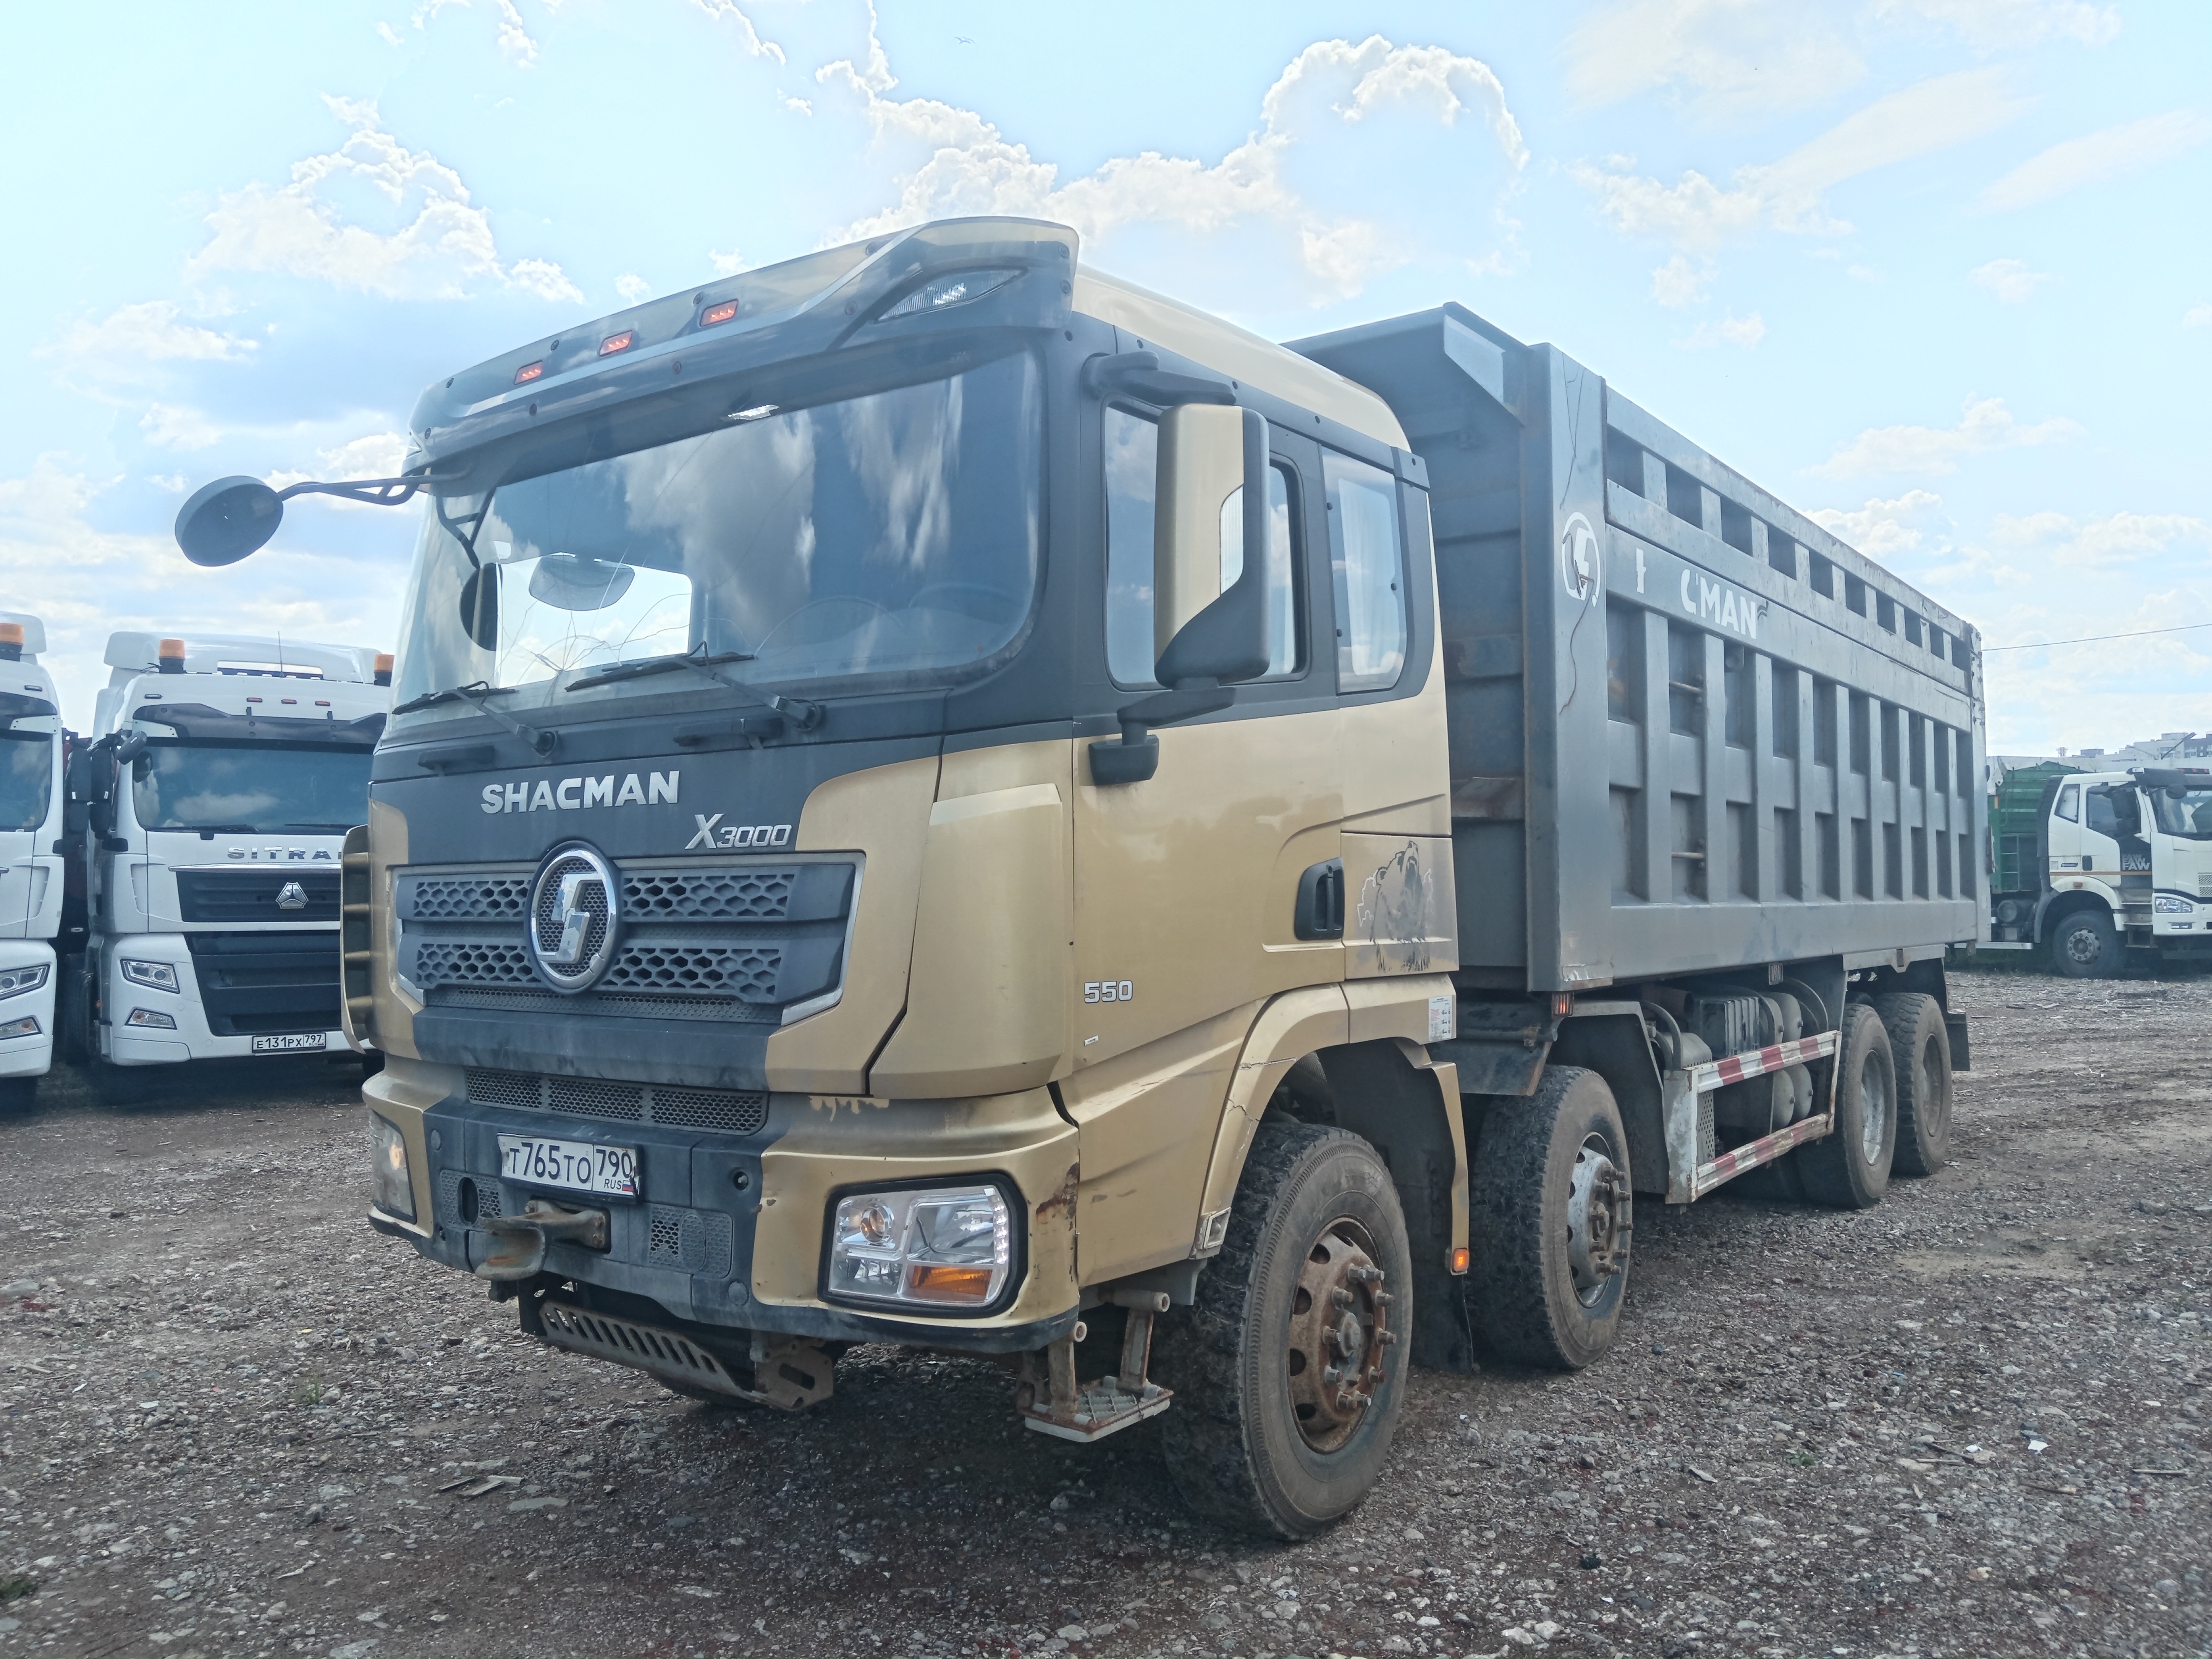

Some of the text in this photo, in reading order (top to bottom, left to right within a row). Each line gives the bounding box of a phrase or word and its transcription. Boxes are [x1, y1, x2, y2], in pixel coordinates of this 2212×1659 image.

[481, 770, 680, 814] SHACMAN
[685, 813, 792, 850] X3000
[228, 846, 342, 859] SITRA
[1084, 980, 1133, 1004] 550
[305, 1035, 322, 1043] 797
[596, 1149, 633, 1179] 790
[604, 1179, 622, 1190] RUS
